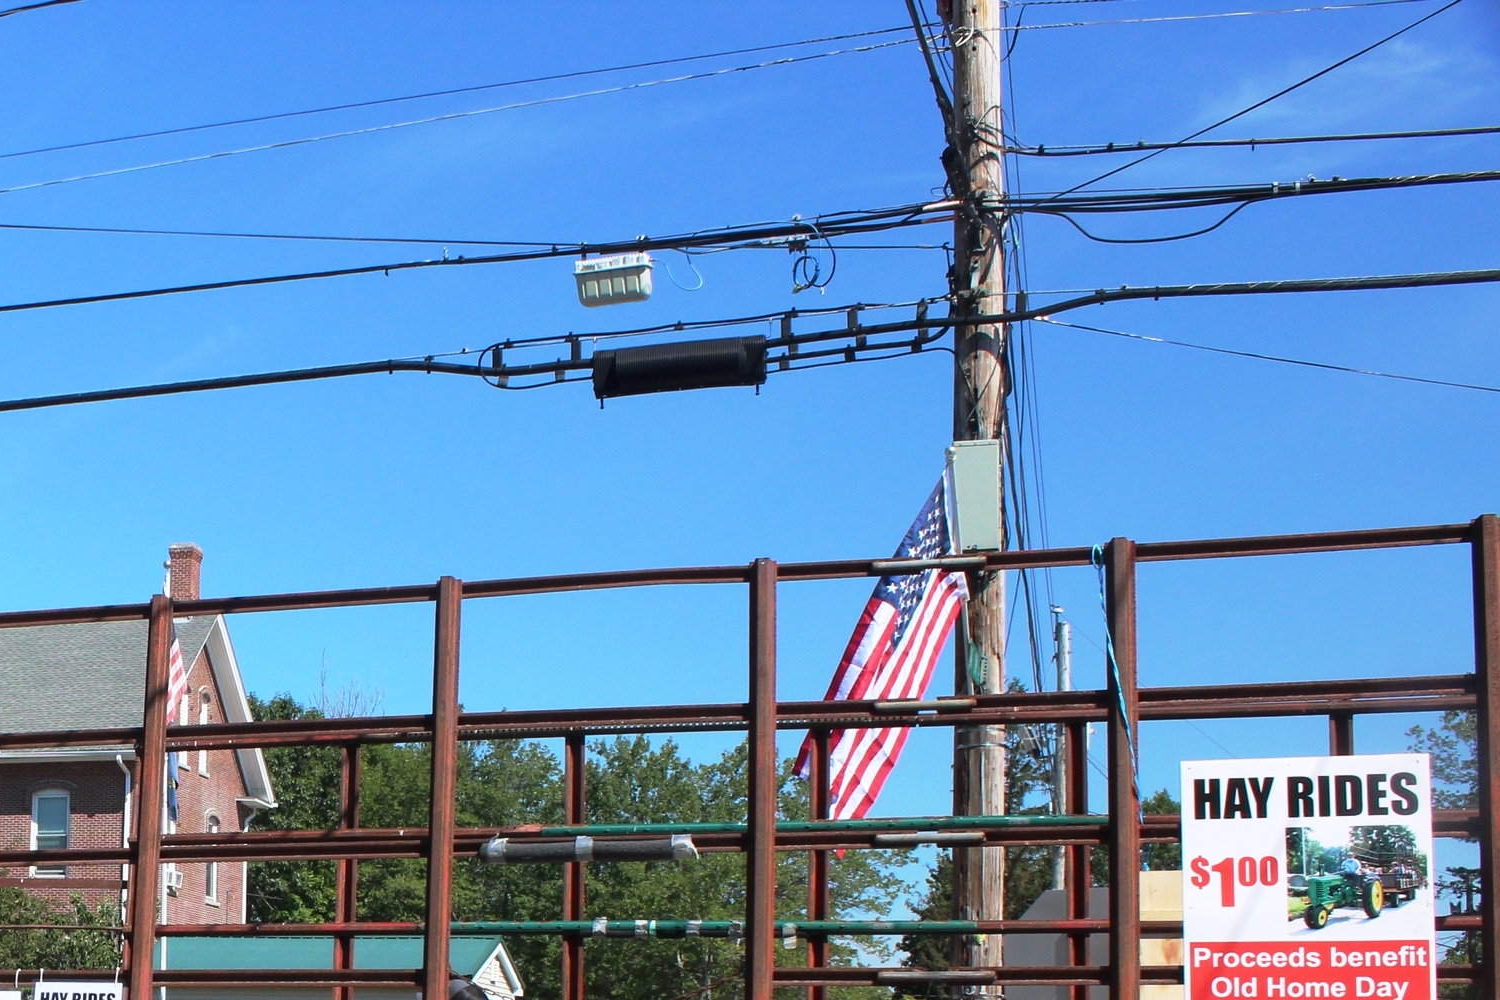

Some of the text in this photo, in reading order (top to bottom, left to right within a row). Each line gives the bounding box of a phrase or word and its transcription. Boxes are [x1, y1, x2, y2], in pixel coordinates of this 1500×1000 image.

[1193, 771, 1419, 820] HAY RIDES
[1193, 946, 1427, 968] Proceeds benefit
[1211, 976, 1257, 998] Old
[1267, 976, 1346, 998] Home
